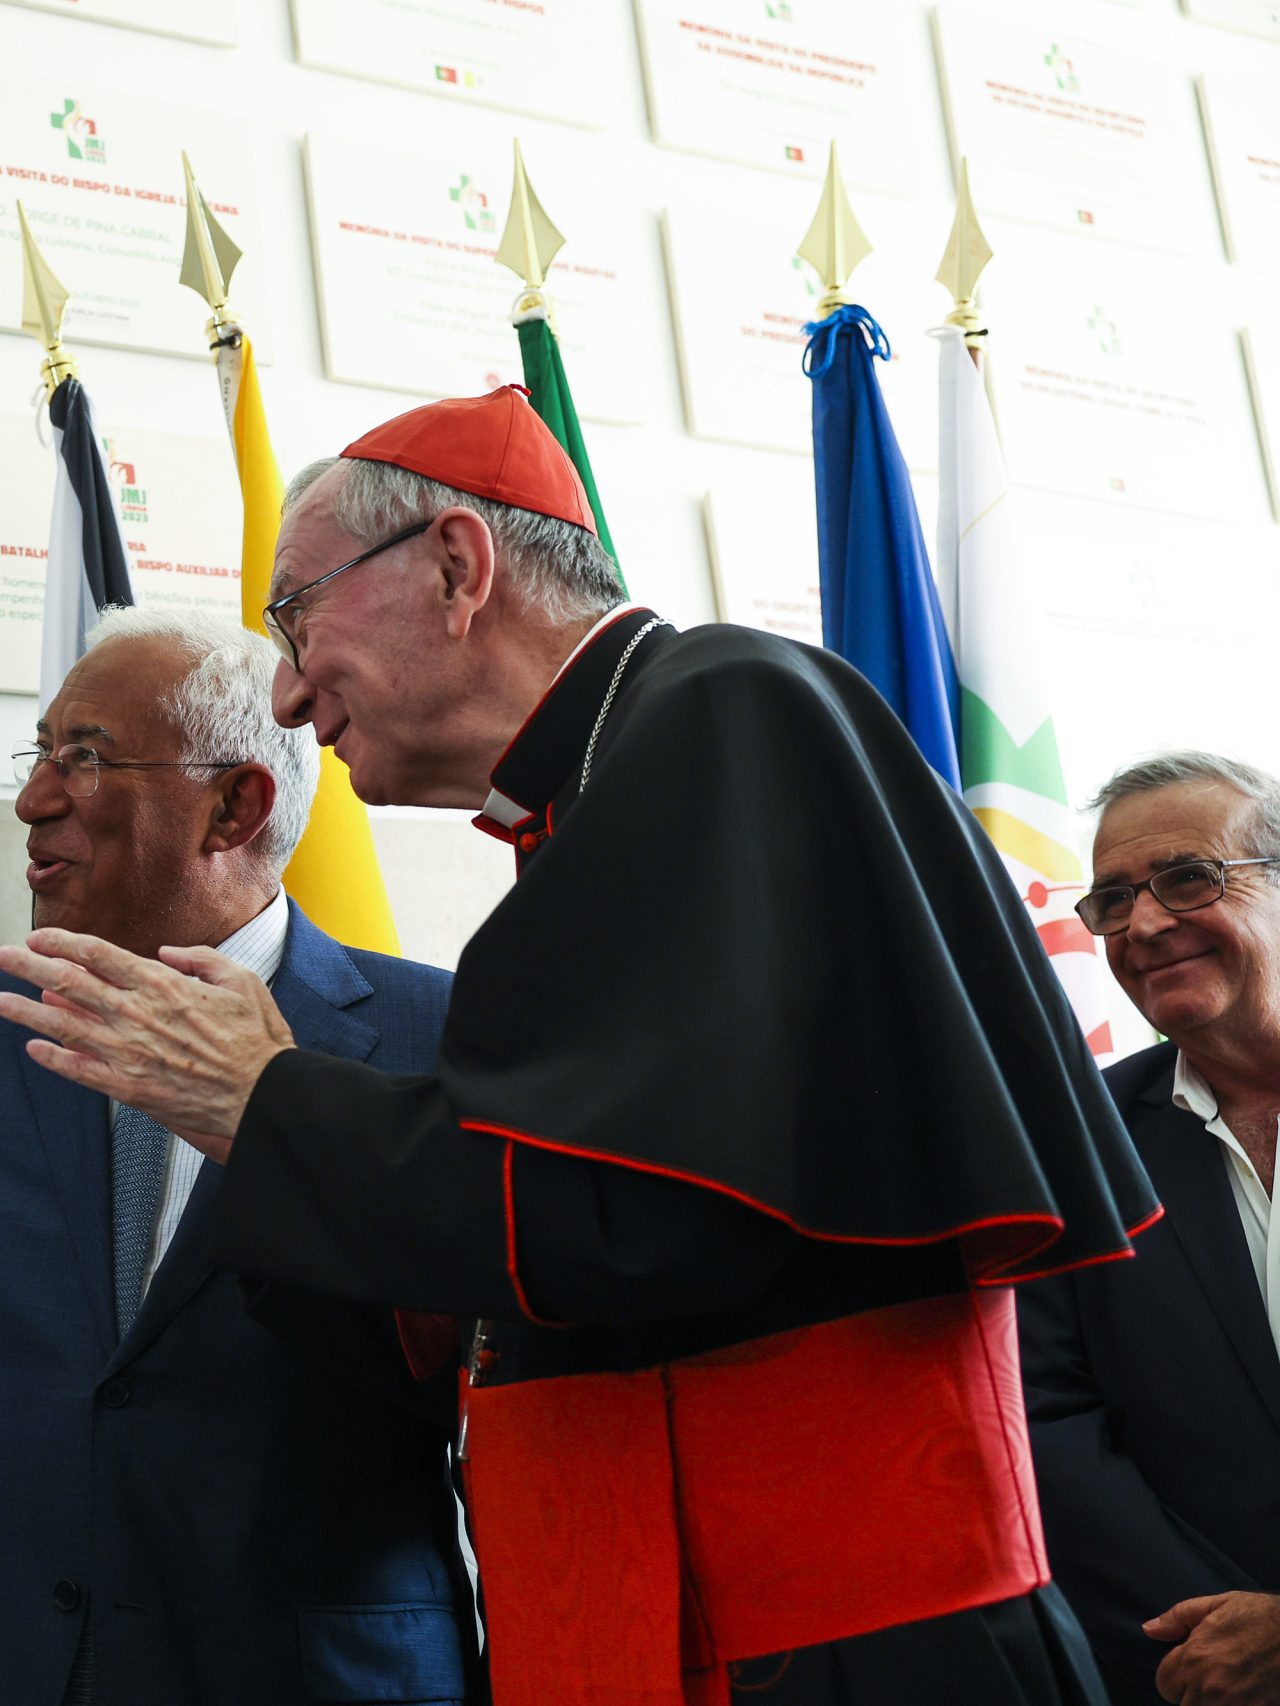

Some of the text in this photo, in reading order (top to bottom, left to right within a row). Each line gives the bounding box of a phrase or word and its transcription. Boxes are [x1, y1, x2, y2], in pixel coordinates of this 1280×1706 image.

[6, 167, 47, 182] VISITA
[51, 175, 69, 186] DO
[72, 178, 111, 193] BISPO
[114, 185, 131, 197] DA
[135, 190, 176, 204] IGREJA
[17, 208, 60, 225] ORGE
[1, 545, 48, 558] BATALH
[137, 559, 173, 572] BISPO
[3, 576, 47, 590] homen
[9, 609, 44, 621] espec
